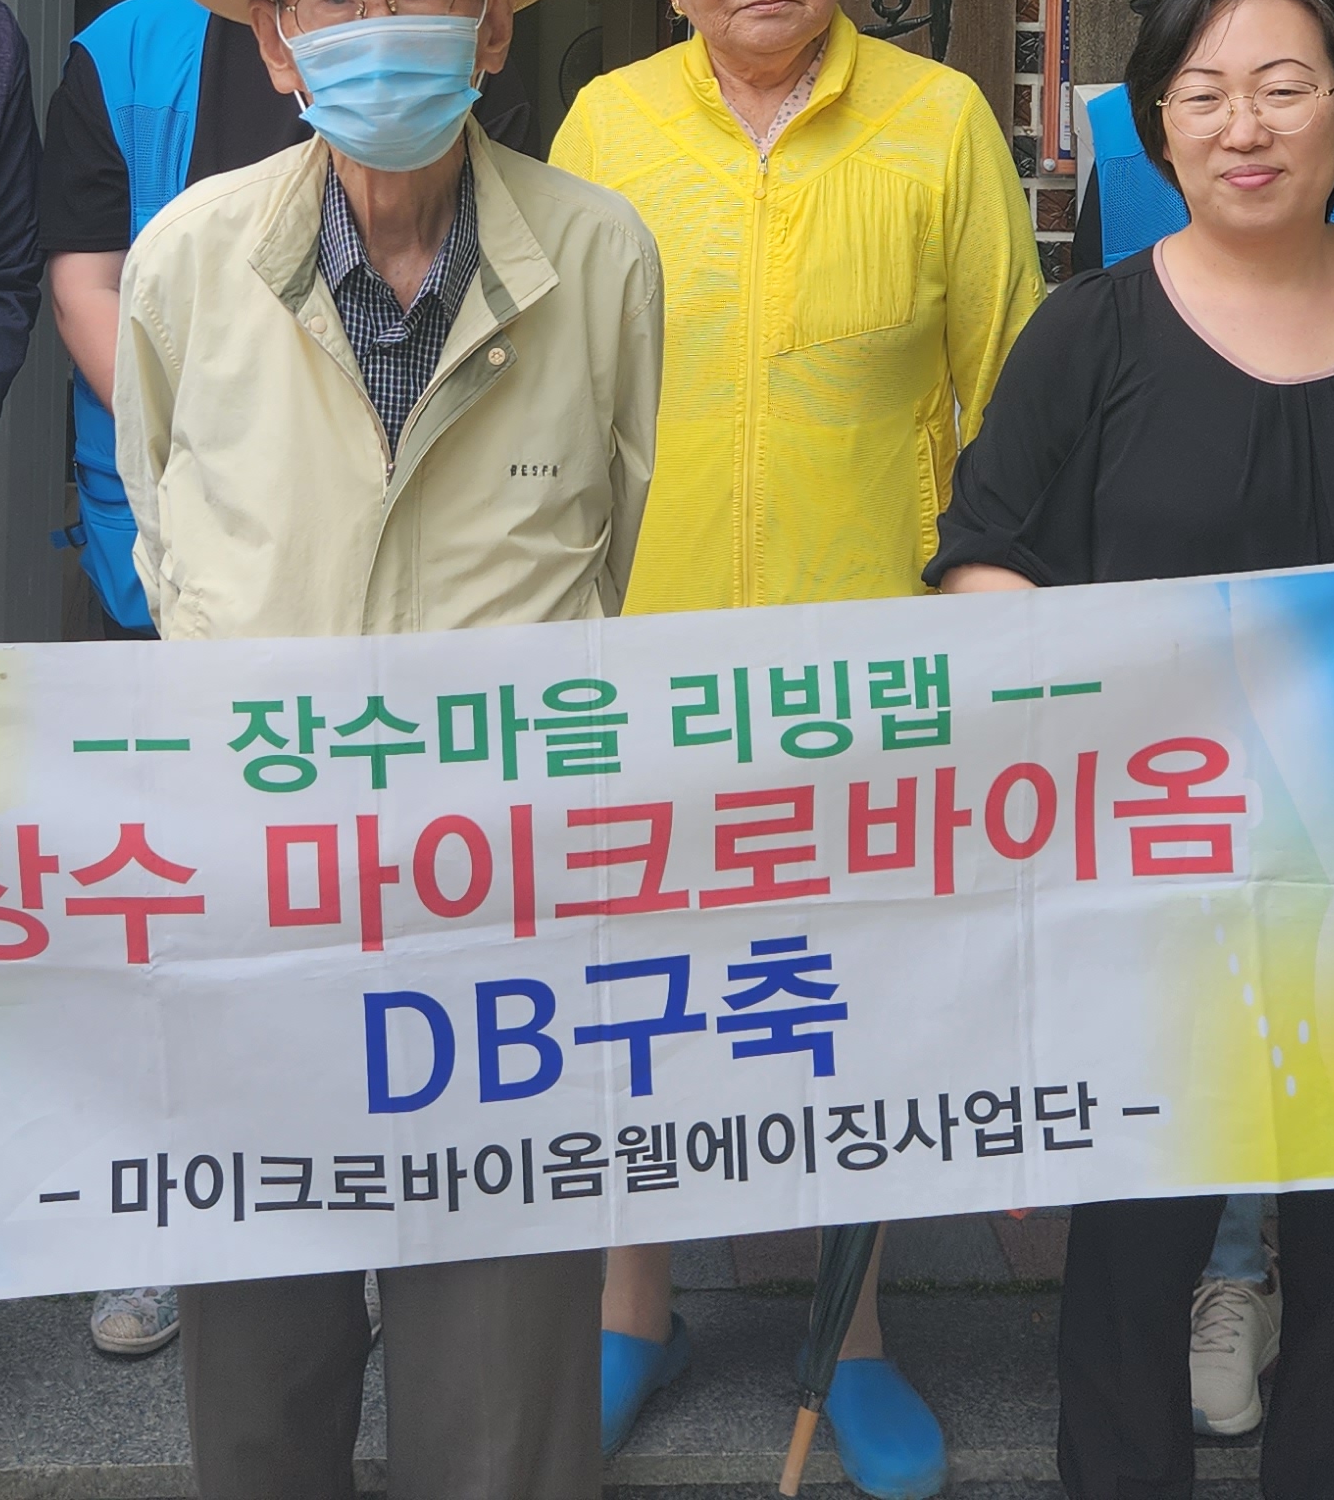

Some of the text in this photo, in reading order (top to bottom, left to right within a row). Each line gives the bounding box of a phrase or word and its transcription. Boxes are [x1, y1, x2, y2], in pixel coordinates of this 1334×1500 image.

[227, 677, 629, 794] 장수마을
[669, 652, 953, 764] 리빙랩
[266, 736, 1248, 953] 마이크로바이옴
[362, 934, 850, 1116] DB구축
[110, 1080, 1099, 1228] 마이크로바이옴웰에이징사업단
